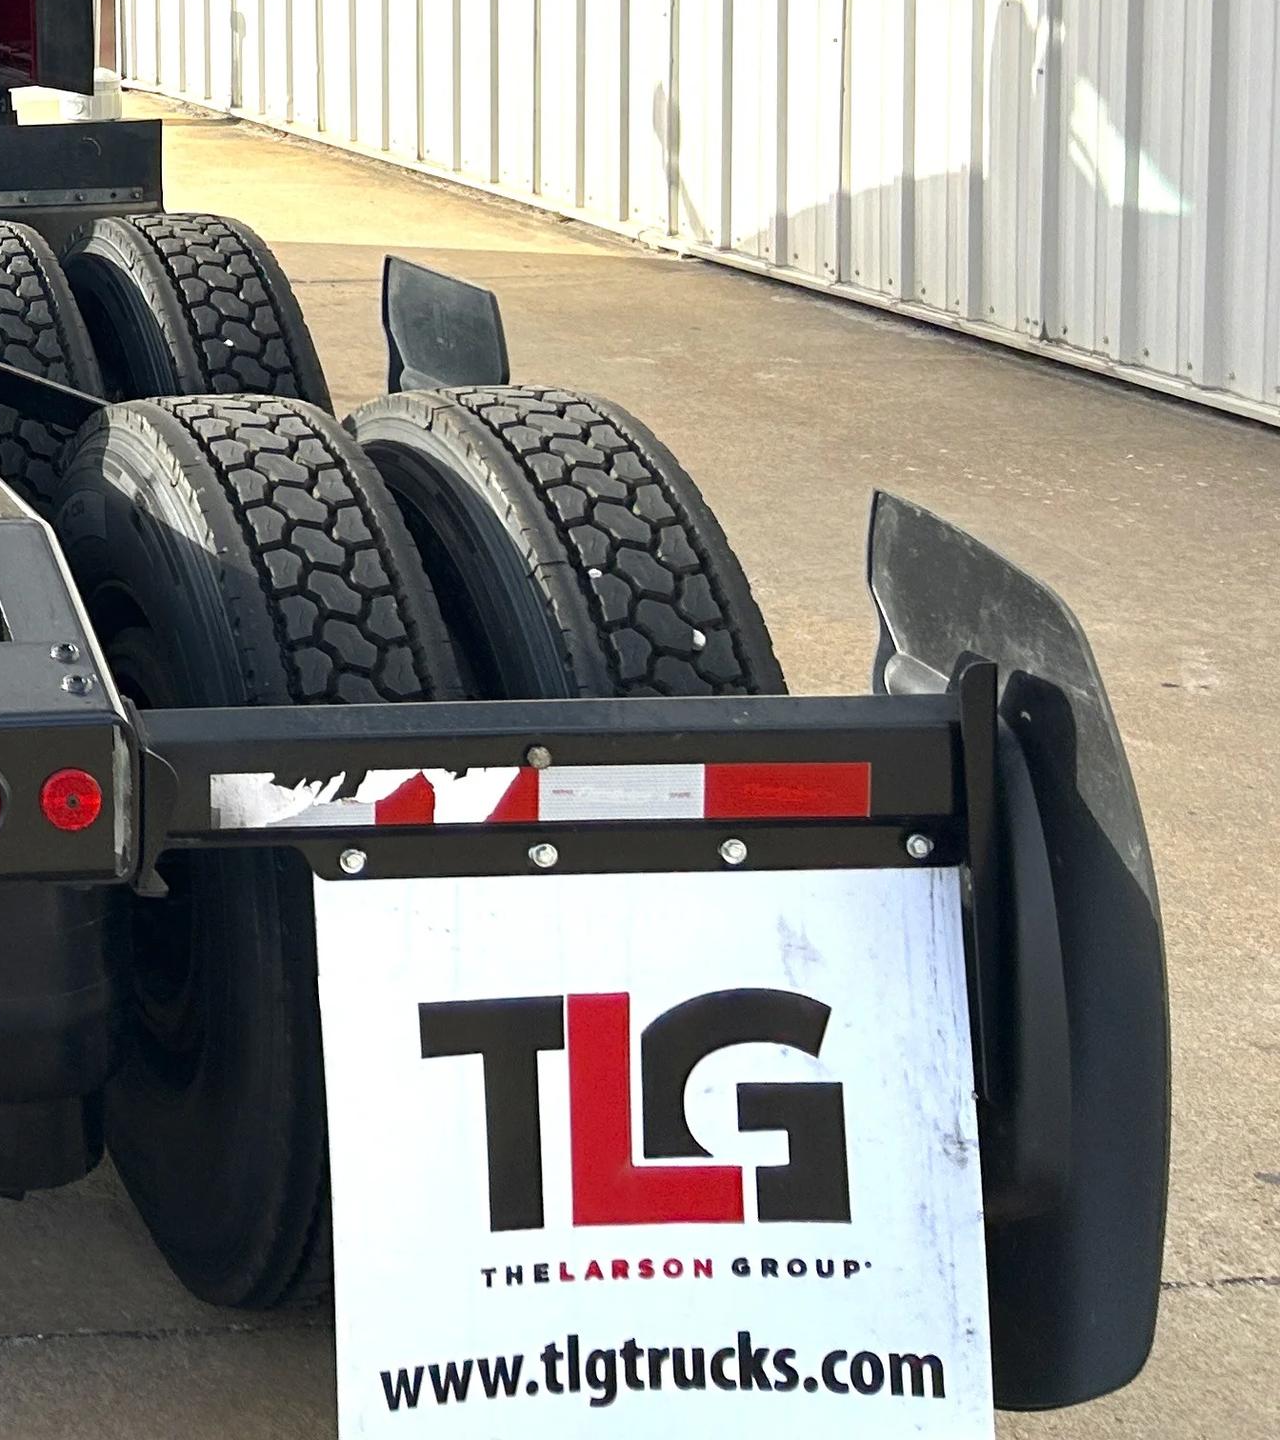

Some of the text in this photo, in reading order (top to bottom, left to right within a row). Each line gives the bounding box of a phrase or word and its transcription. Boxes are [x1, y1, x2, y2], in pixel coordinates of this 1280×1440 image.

[418, 987, 852, 1232] TLG
[731, 1257, 862, 1280] GROUP
[380, 1331, 946, 1412] www.tlgtrucks.com
